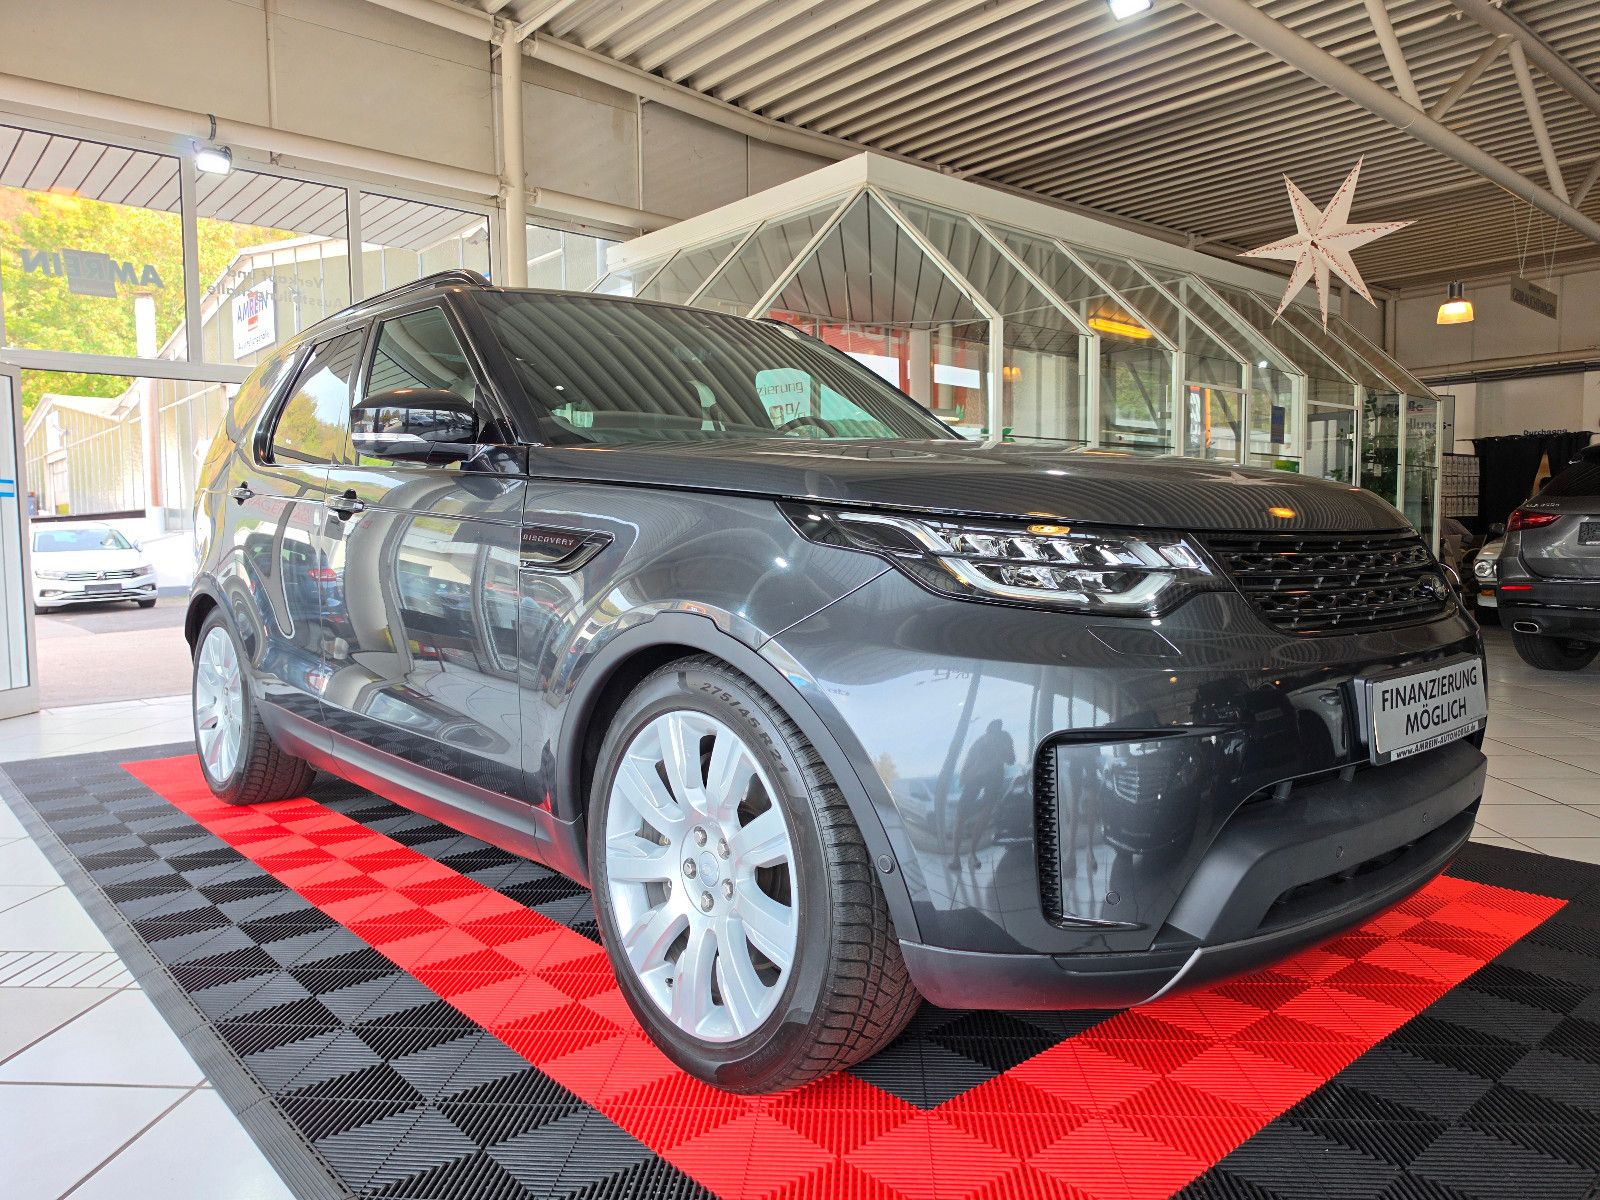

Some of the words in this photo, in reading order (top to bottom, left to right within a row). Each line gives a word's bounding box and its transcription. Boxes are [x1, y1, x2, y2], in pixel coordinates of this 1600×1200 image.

[237, 291, 268, 322] AMREIN
[522, 533, 575, 546] DISCOVERY
[1381, 666, 1477, 712] FINANZIERUNG
[1405, 696, 1467, 736] MÖGLICH
